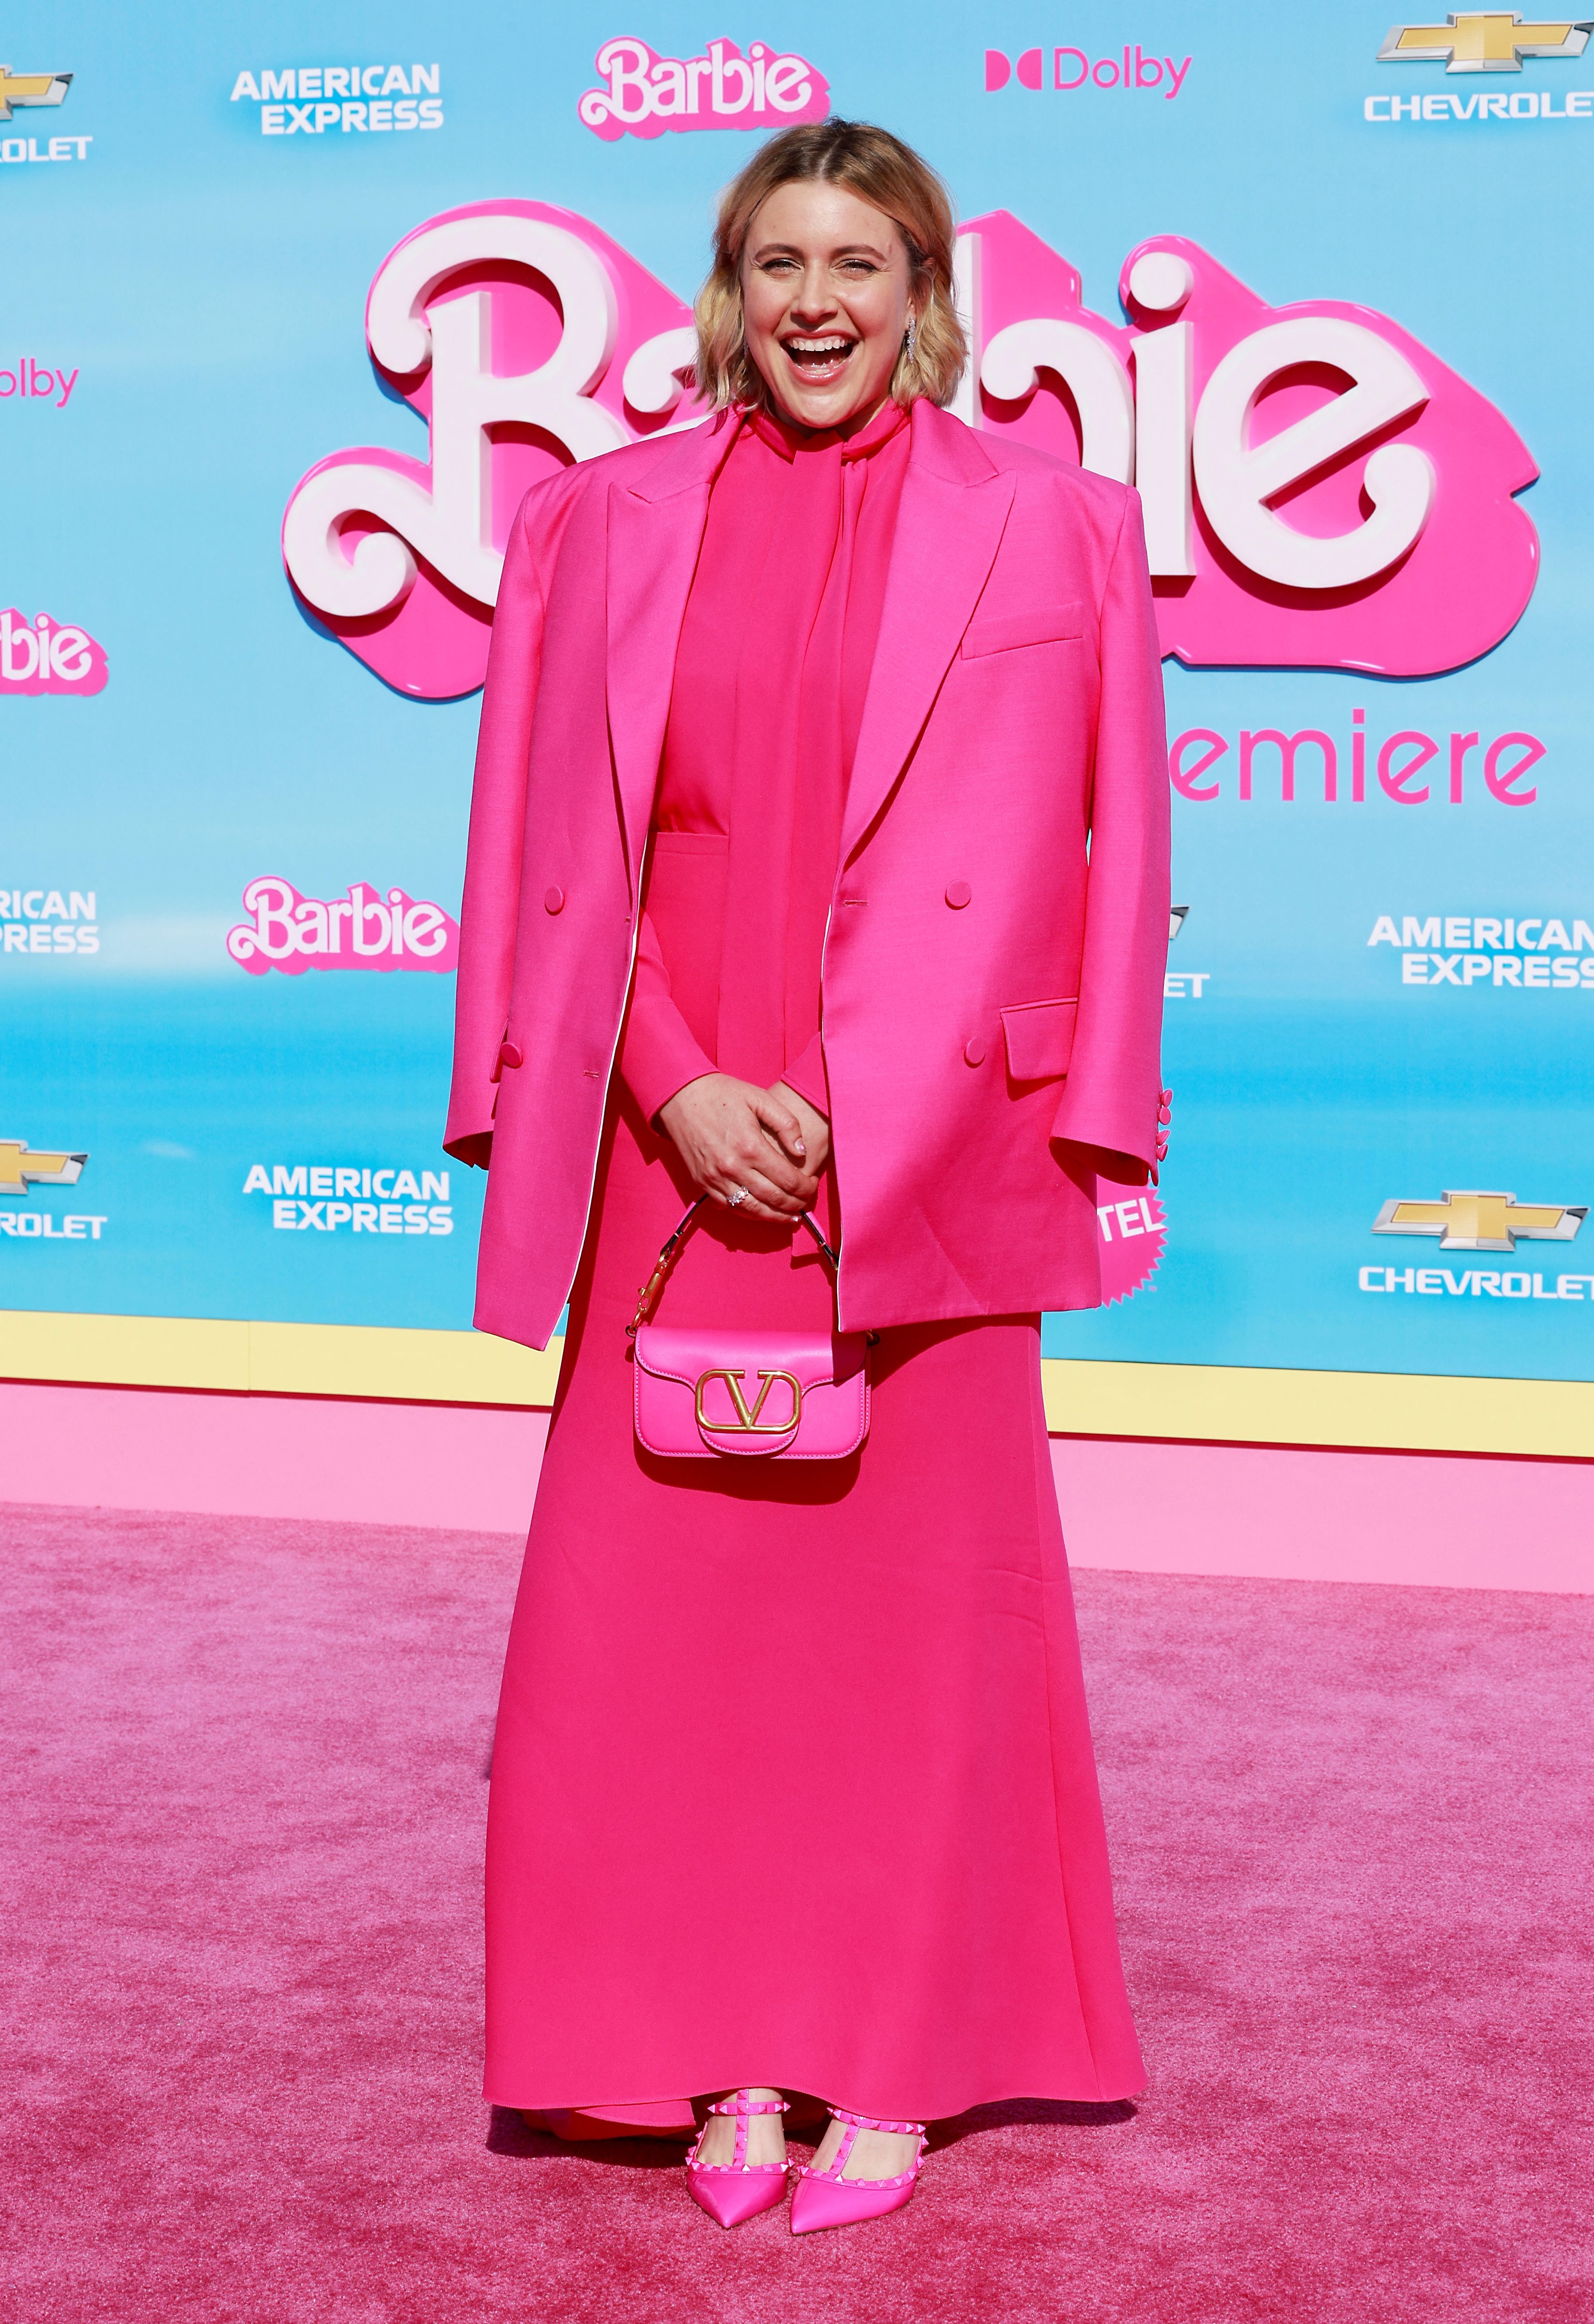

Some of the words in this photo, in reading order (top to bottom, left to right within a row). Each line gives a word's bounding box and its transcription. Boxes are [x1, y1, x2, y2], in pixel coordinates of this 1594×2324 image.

[230, 63, 440, 101] AMERICAN
[580, 39, 812, 125] Barbie
[1054, 45, 1192, 99] Dolby
[261, 99, 444, 135] EXPRESS
[0, 136, 93, 163] OLET
[0, 612, 93, 681] bie
[1169, 708, 1547, 807] emiere
[228, 878, 447, 959] Barbie
[1367, 916, 1594, 950] AMERICAN
[0, 924, 100, 954] RESS
[243, 1165, 450, 1201] AMERICAN
[273, 1199, 454, 1235] EXPRESS
[1359, 1266, 1594, 1300] CHEVROLE
